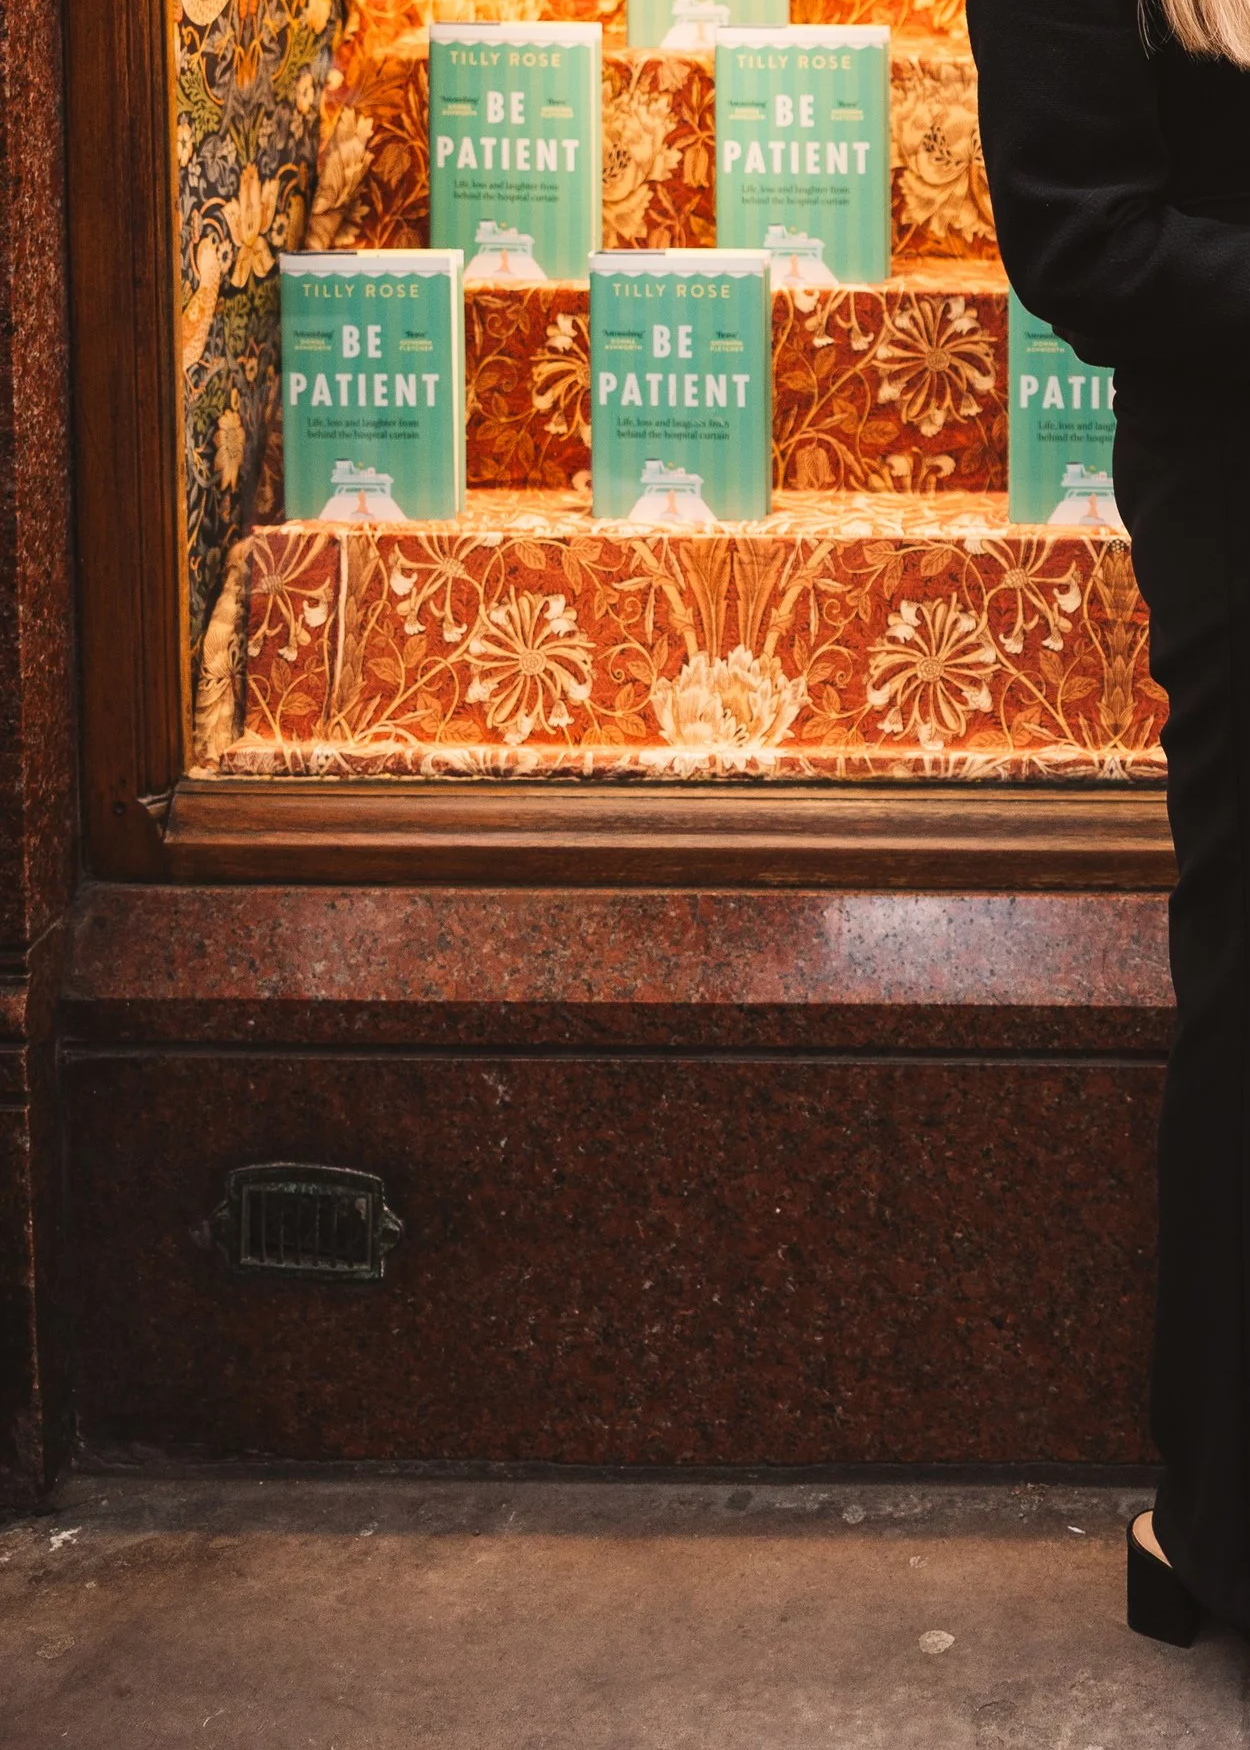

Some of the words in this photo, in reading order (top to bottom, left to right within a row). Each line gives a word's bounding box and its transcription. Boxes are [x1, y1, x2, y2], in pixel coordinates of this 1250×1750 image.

[450, 51, 500, 66] TILLY
[509, 52, 561, 67] ROSE
[737, 55, 788, 70] TILLY
[798, 55, 851, 70] ROSE
[487, 90, 525, 124] BE
[775, 94, 815, 128] BE
[436, 136, 579, 172] PATIENT
[723, 140, 870, 175] PATIENT
[303, 284, 355, 298] TILLY
[365, 284, 420, 298] ROSE
[613, 283, 666, 298] TILLY
[676, 284, 731, 299] ROSE
[342, 325, 382, 359] BE
[653, 324, 693, 359] BE
[289, 372, 440, 407] PATIENT
[599, 372, 750, 407] PATIENT
